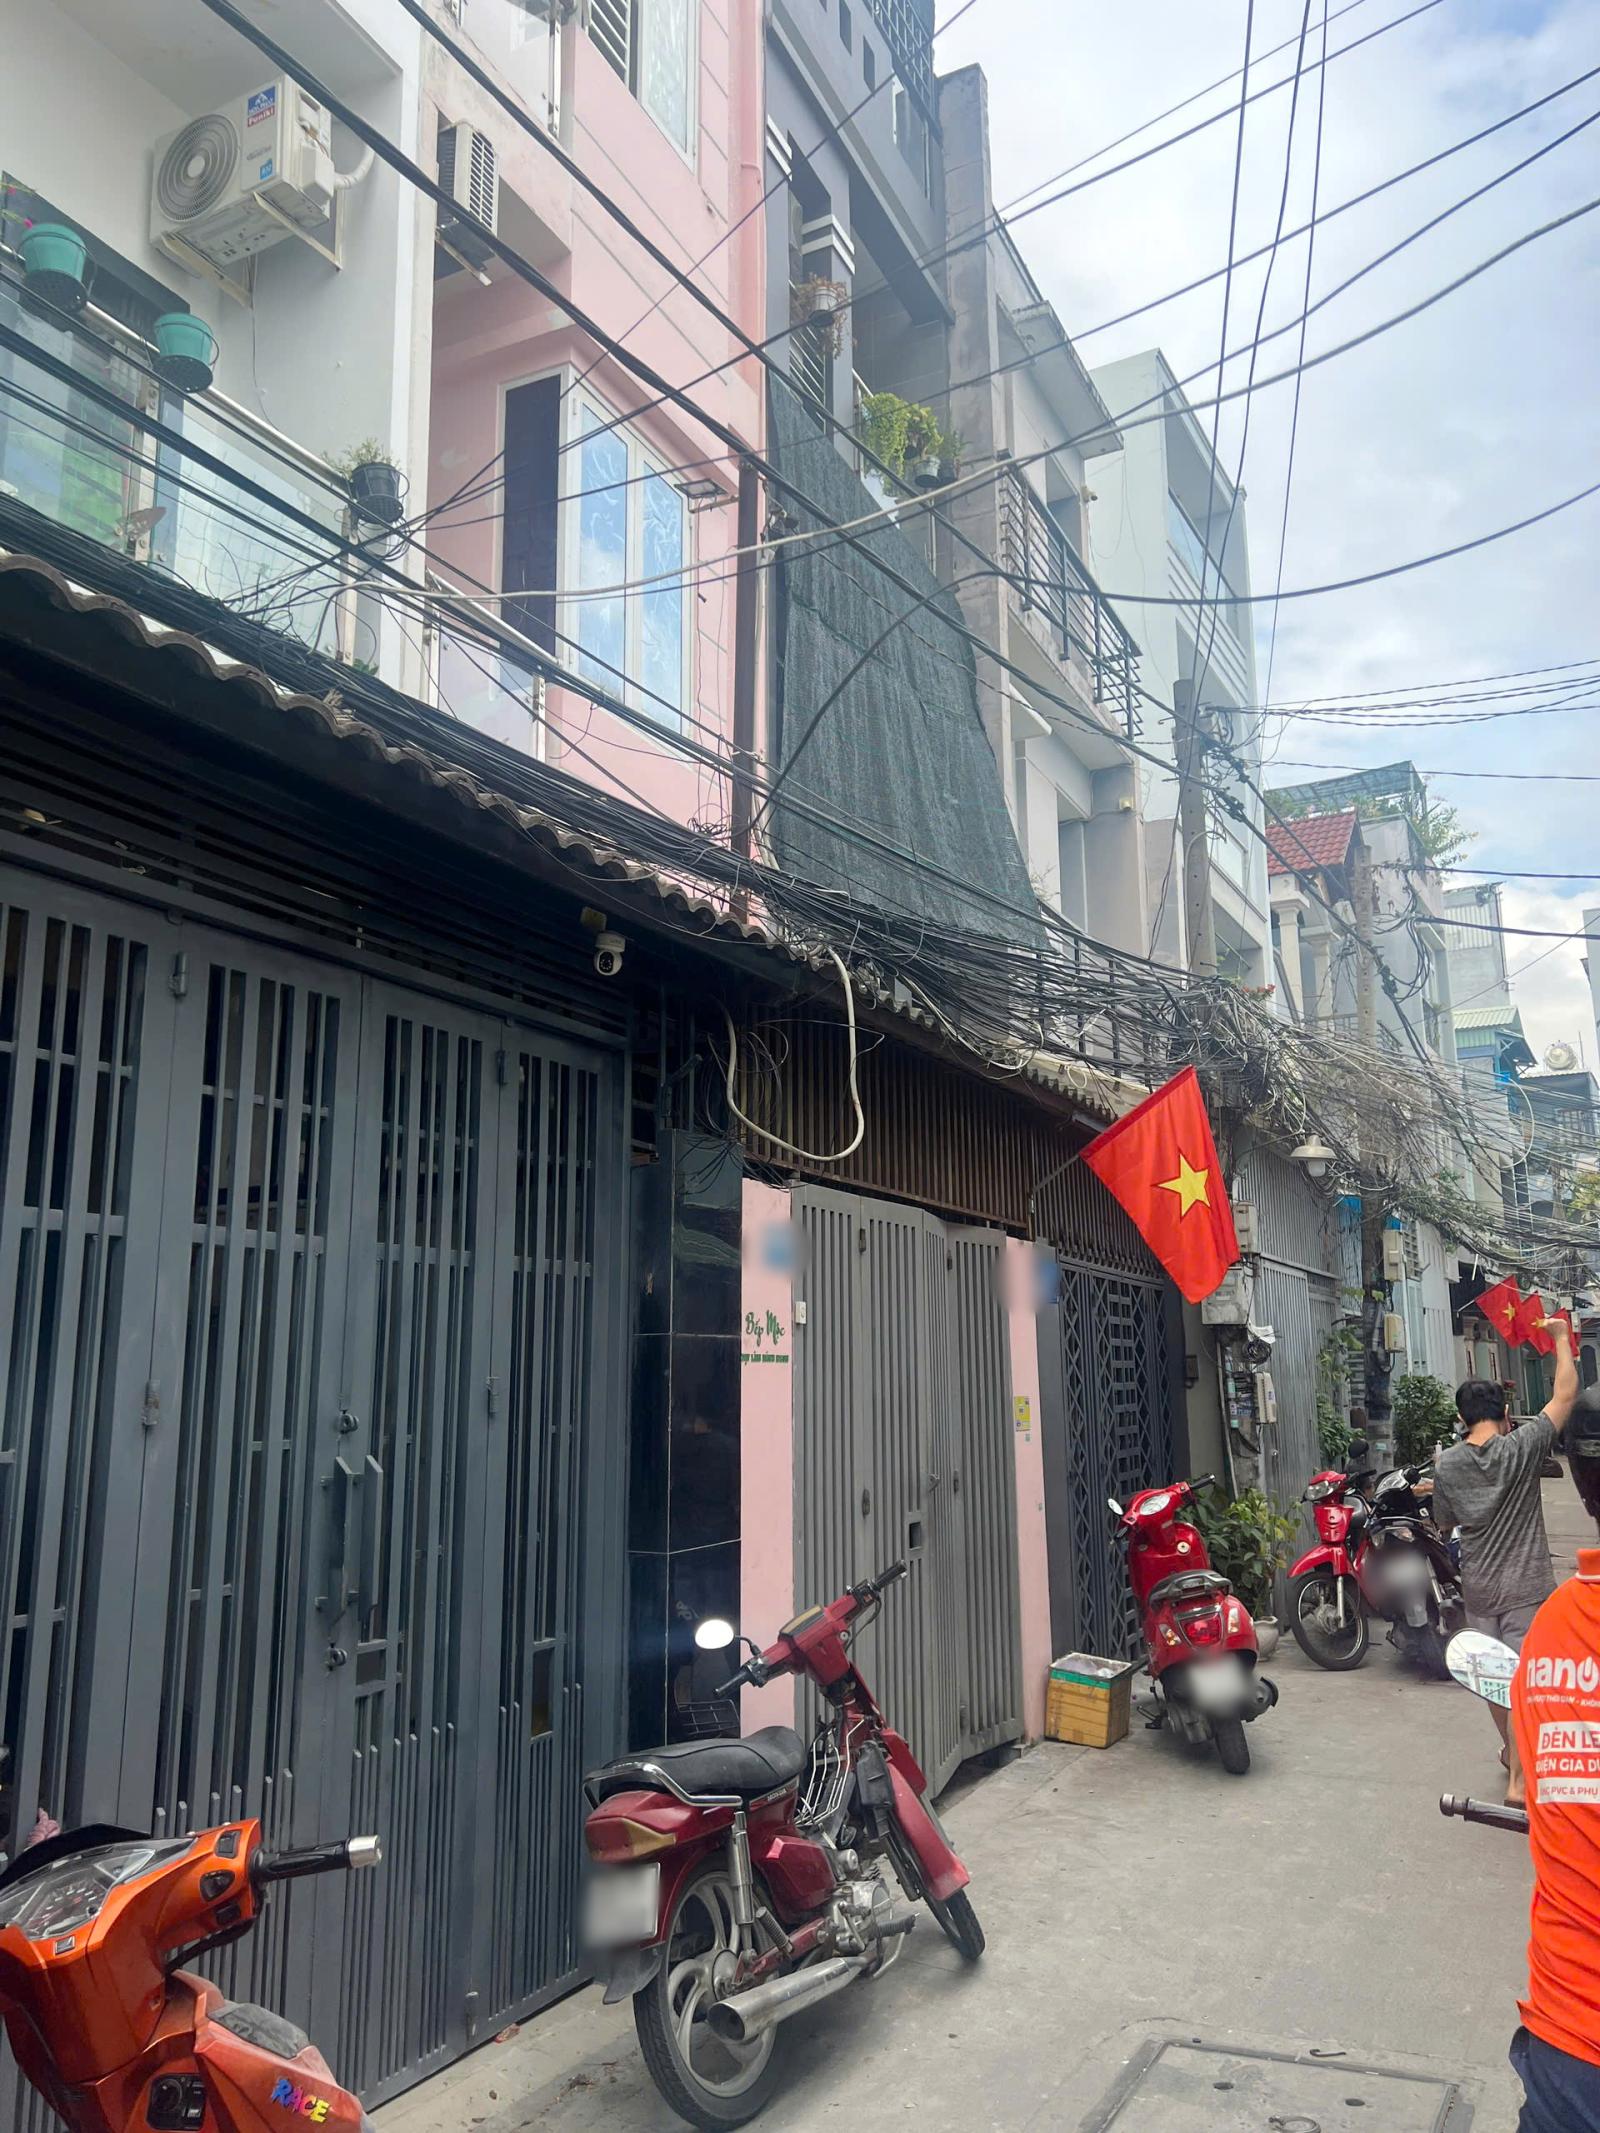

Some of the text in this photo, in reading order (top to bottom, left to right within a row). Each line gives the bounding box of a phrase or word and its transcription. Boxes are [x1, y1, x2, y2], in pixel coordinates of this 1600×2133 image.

[1560, 1758, 1585, 1772] GIA
[1551, 1786, 1569, 1796] PVC
[271, 2077, 330, 2123] RACE
